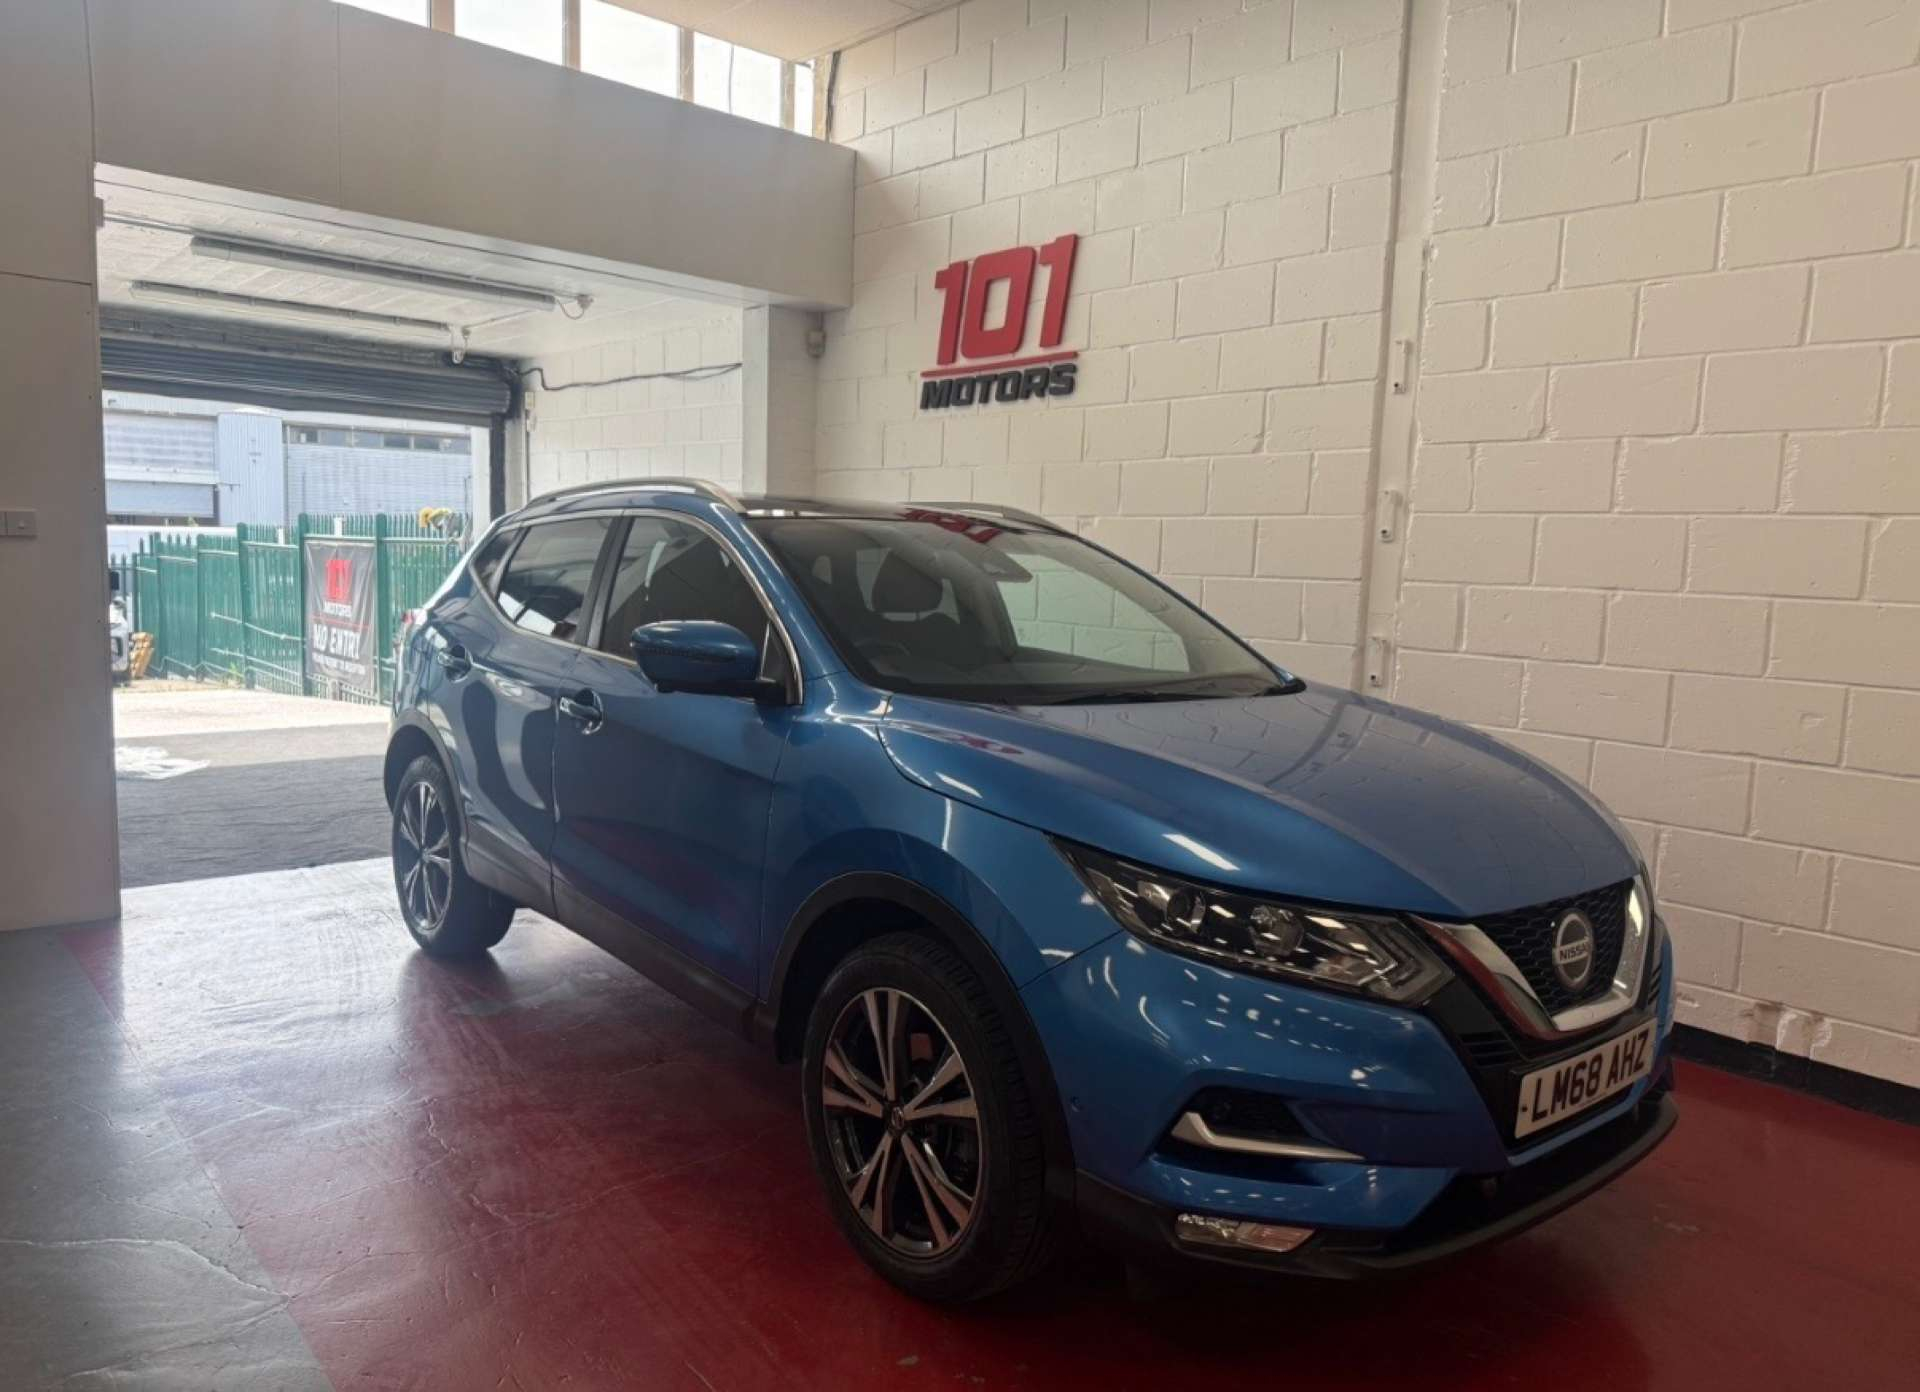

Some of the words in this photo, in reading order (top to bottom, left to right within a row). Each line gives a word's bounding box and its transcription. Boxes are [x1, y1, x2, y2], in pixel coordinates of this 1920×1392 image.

[934, 234, 1078, 366] 101
[920, 363, 1077, 410] MOTORS
[1531, 1054, 1601, 1123] LM68
[1607, 1030, 1649, 1084] AHZ
